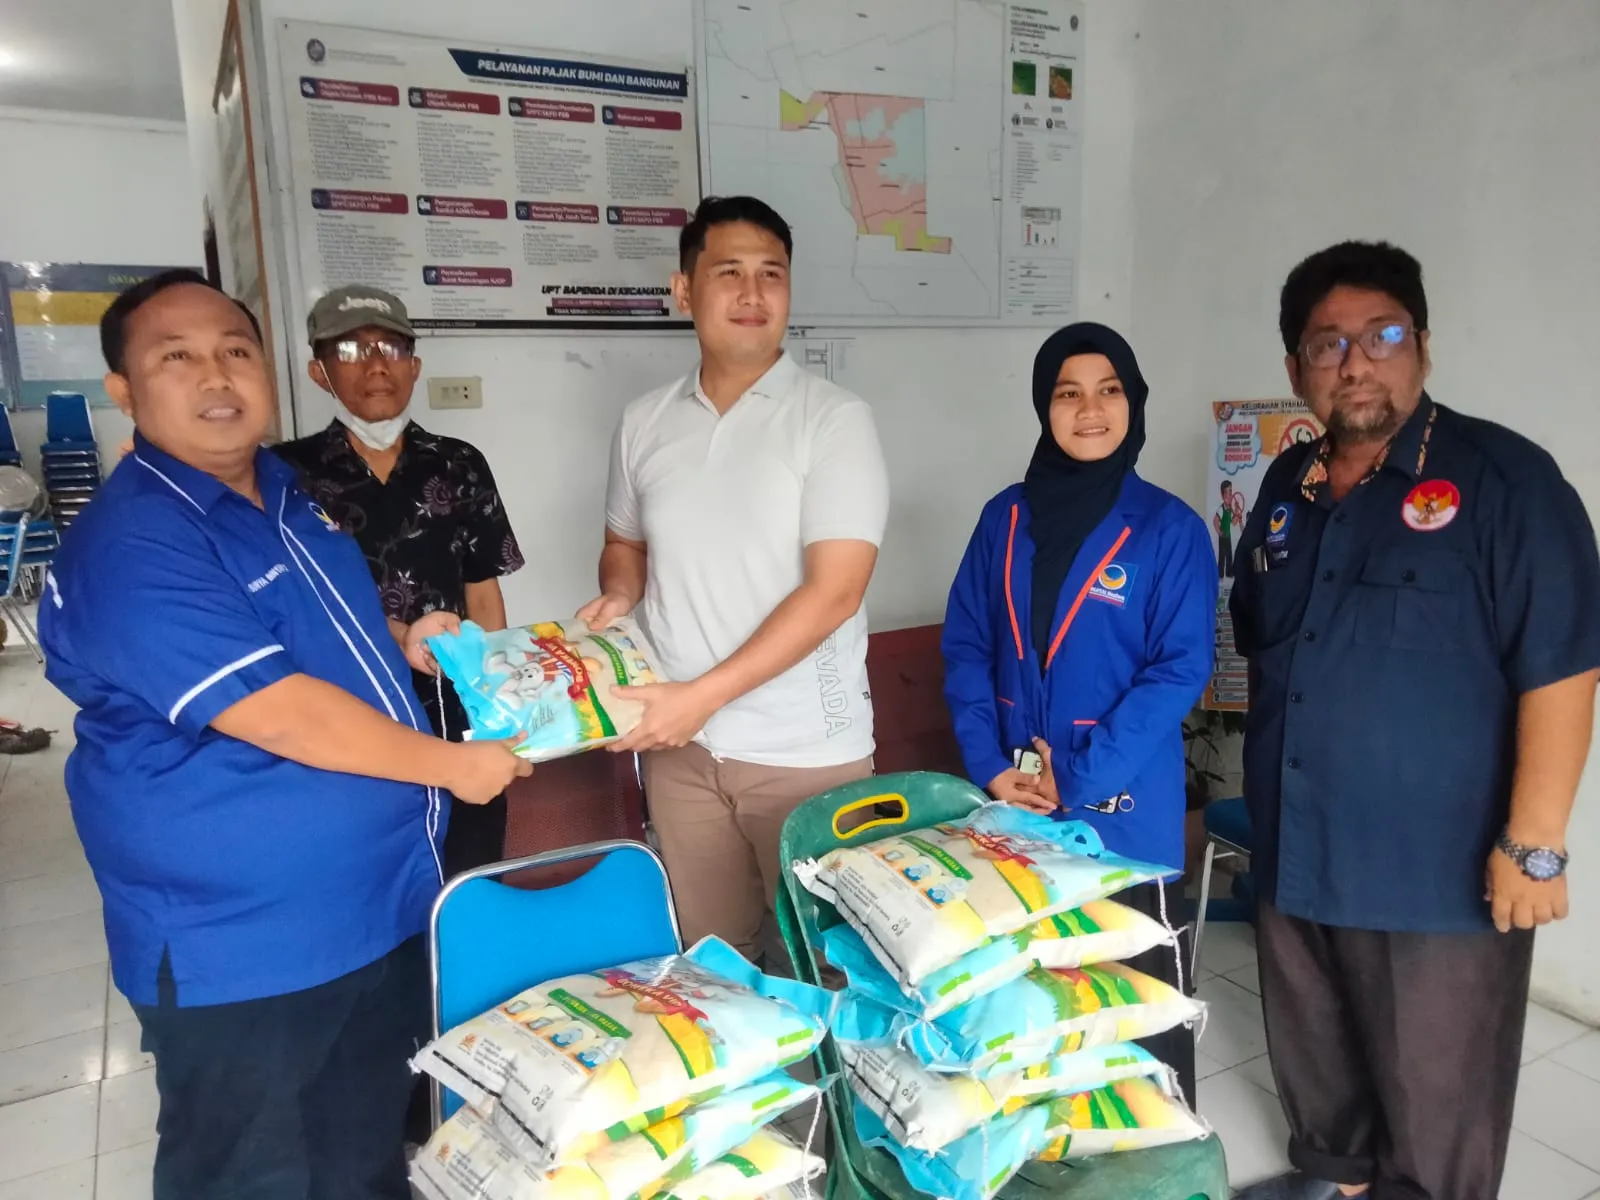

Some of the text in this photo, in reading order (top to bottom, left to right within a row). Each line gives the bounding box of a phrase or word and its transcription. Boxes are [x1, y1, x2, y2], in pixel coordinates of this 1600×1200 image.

[478, 59, 680, 91] PELAYANAN PAJAK BUMI DAN BANGUNAN
[541, 285, 561, 295] UPT
[1225, 423, 1252, 433] JANGAN
[815, 630, 851, 738] EVADA
